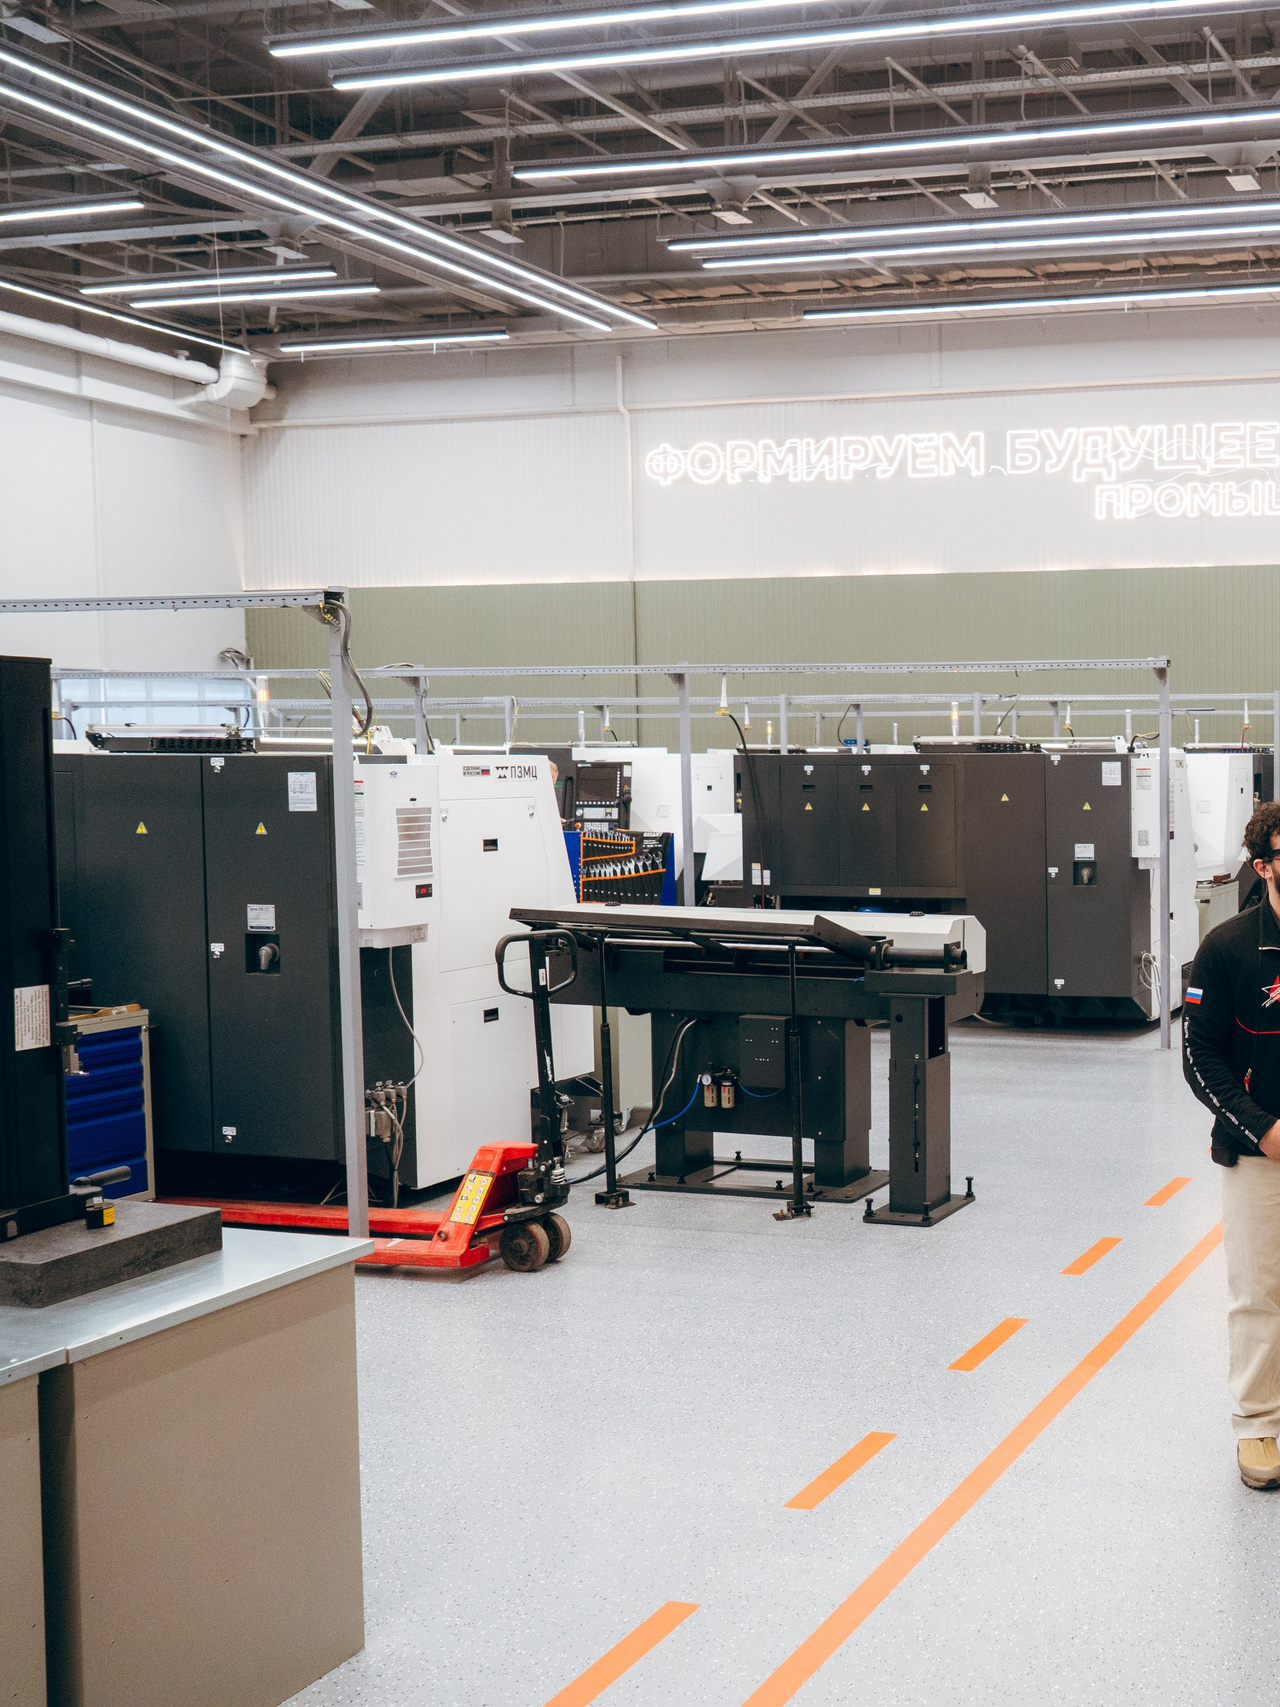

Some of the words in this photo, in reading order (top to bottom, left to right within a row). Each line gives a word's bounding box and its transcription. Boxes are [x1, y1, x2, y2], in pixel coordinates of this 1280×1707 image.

[644, 431, 985, 485] ФОРМИРУЕМ
[1006, 422, 1280, 482] БУДУЩЕЕ
[510, 765, 538, 780] ПЗМЦ
